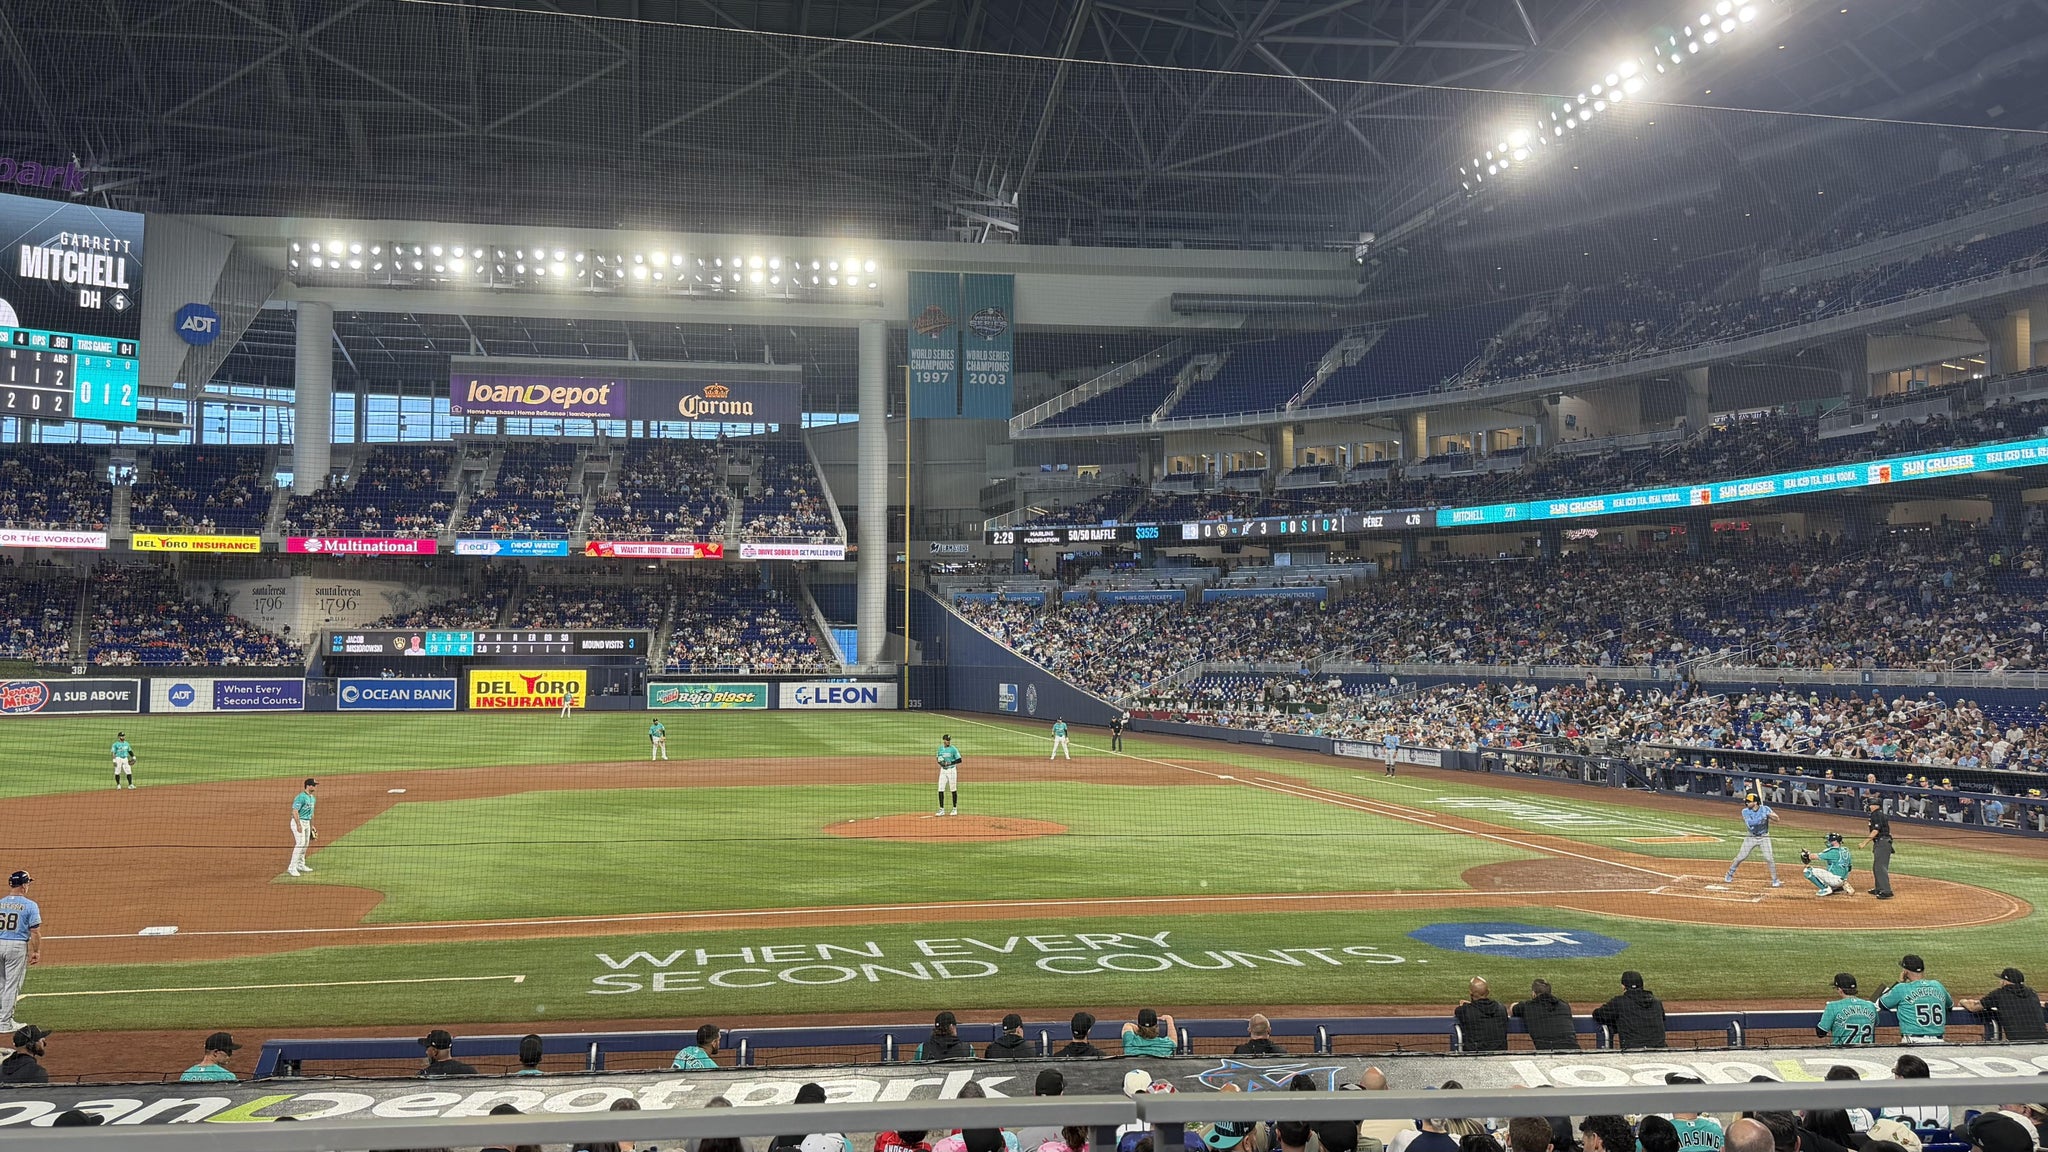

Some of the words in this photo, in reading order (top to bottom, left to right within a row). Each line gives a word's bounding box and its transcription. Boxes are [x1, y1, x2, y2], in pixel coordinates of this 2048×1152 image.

[60, 232, 130, 253] GARRETT
[20, 245, 129, 289] MITCHELL
[80, 290, 100, 308] DH
[115, 296, 124, 310] 5
[180, 316, 216, 332] ADT
[18, 334, 24, 344] 4
[32, 335, 46, 346] OPS
[10, 350, 16, 358] H
[36, 352, 41, 361] E
[54, 354, 68, 364] ABS
[911, 349, 932, 360] WORLD
[933, 350, 954, 360] SERIES
[966, 350, 988, 360] WORLD
[988, 351, 1010, 361] SERIES
[911, 360, 954, 370] CHAMPIONS
[966, 361, 1010, 372] CHAMPIONS
[12, 366, 16, 382] 1
[36, 368, 40, 384] 1
[56, 370, 64, 386] 2
[916, 372, 948, 383] 1997
[970, 374, 1006, 384] 2003
[81, 382, 91, 404] 0
[104, 383, 110, 404] 1
[121, 384, 132, 406] 2
[468, 380, 610, 409] loanDepot
[8, 392, 16, 408] 2
[32, 394, 40, 410] 0
[55, 396, 62, 412] 2
[678, 394, 754, 420] Corona
[1902, 460, 1924, 474] SUN
[1926, 455, 1974, 472] CRUISER
[1720, 486, 1736, 497] SUN
[1738, 481, 1774, 494] CRUISER
[1784, 480, 1796, 488] REAL
[1822, 474, 1836, 484] REAL
[1550, 504, 1568, 514] SUN
[1570, 500, 1604, 513] CRUISER
[1453, 510, 1484, 522] MITCHELL
[1205, 525, 1210, 537] 0
[1261, 522, 1266, 534] 3
[1280, 522, 1286, 534] B
[1290, 520, 1296, 533] 0
[1302, 520, 1308, 532] S
[1332, 518, 1338, 532] 2
[0, 534, 16, 542] OR
[21, 534, 41, 543] THE
[994, 532, 1014, 544] 2:29
[1068, 530, 1090, 542] 50/50
[1091, 529, 1116, 540] RAFFLE
[1136, 528, 1158, 540] $3525
[158, 538, 188, 548] TORO
[192, 541, 257, 550] INSURANCE
[324, 540, 418, 552] Multinational
[320, 597, 356, 615] 1796
[334, 636, 342, 644] 32
[346, 636, 364, 644] JACOB
[582, 640, 604, 649] MOUND
[605, 640, 624, 649] VISITS
[628, 638, 634, 648] 3
[477, 645, 487, 653] 2.0
[496, 645, 500, 653] 2
[512, 645, 517, 653] 3
[561, 645, 566, 653] 4
[72, 666, 87, 675] 387
[476, 682, 516, 694] DEL
[520, 673, 580, 694] TORO
[0, 686, 42, 698] Jersey
[53, 692, 62, 702] A
[64, 692, 88, 702] SUB
[90, 690, 128, 702] ABOVE
[172, 691, 191, 700] ADT
[224, 685, 252, 694] When
[256, 685, 282, 696] Every
[362, 688, 410, 700] OCEAN
[414, 688, 452, 700] BANK
[815, 687, 878, 704] LEON
[224, 696, 264, 705] Second
[266, 696, 301, 705] Counts.
[678, 692, 712, 704] Baja
[713, 692, 756, 703] Blast
[908, 700, 922, 708] 335
[1464, 931, 1582, 950] ADT
[595, 941, 885, 970] WHEN
[914, 931, 1172, 956] EVERY
[586, 960, 999, 995] SECOND
[1035, 946, 1430, 975] COUNTS.
[1915, 1004, 1944, 1026] 56
[1845, 1024, 1872, 1044] 72
